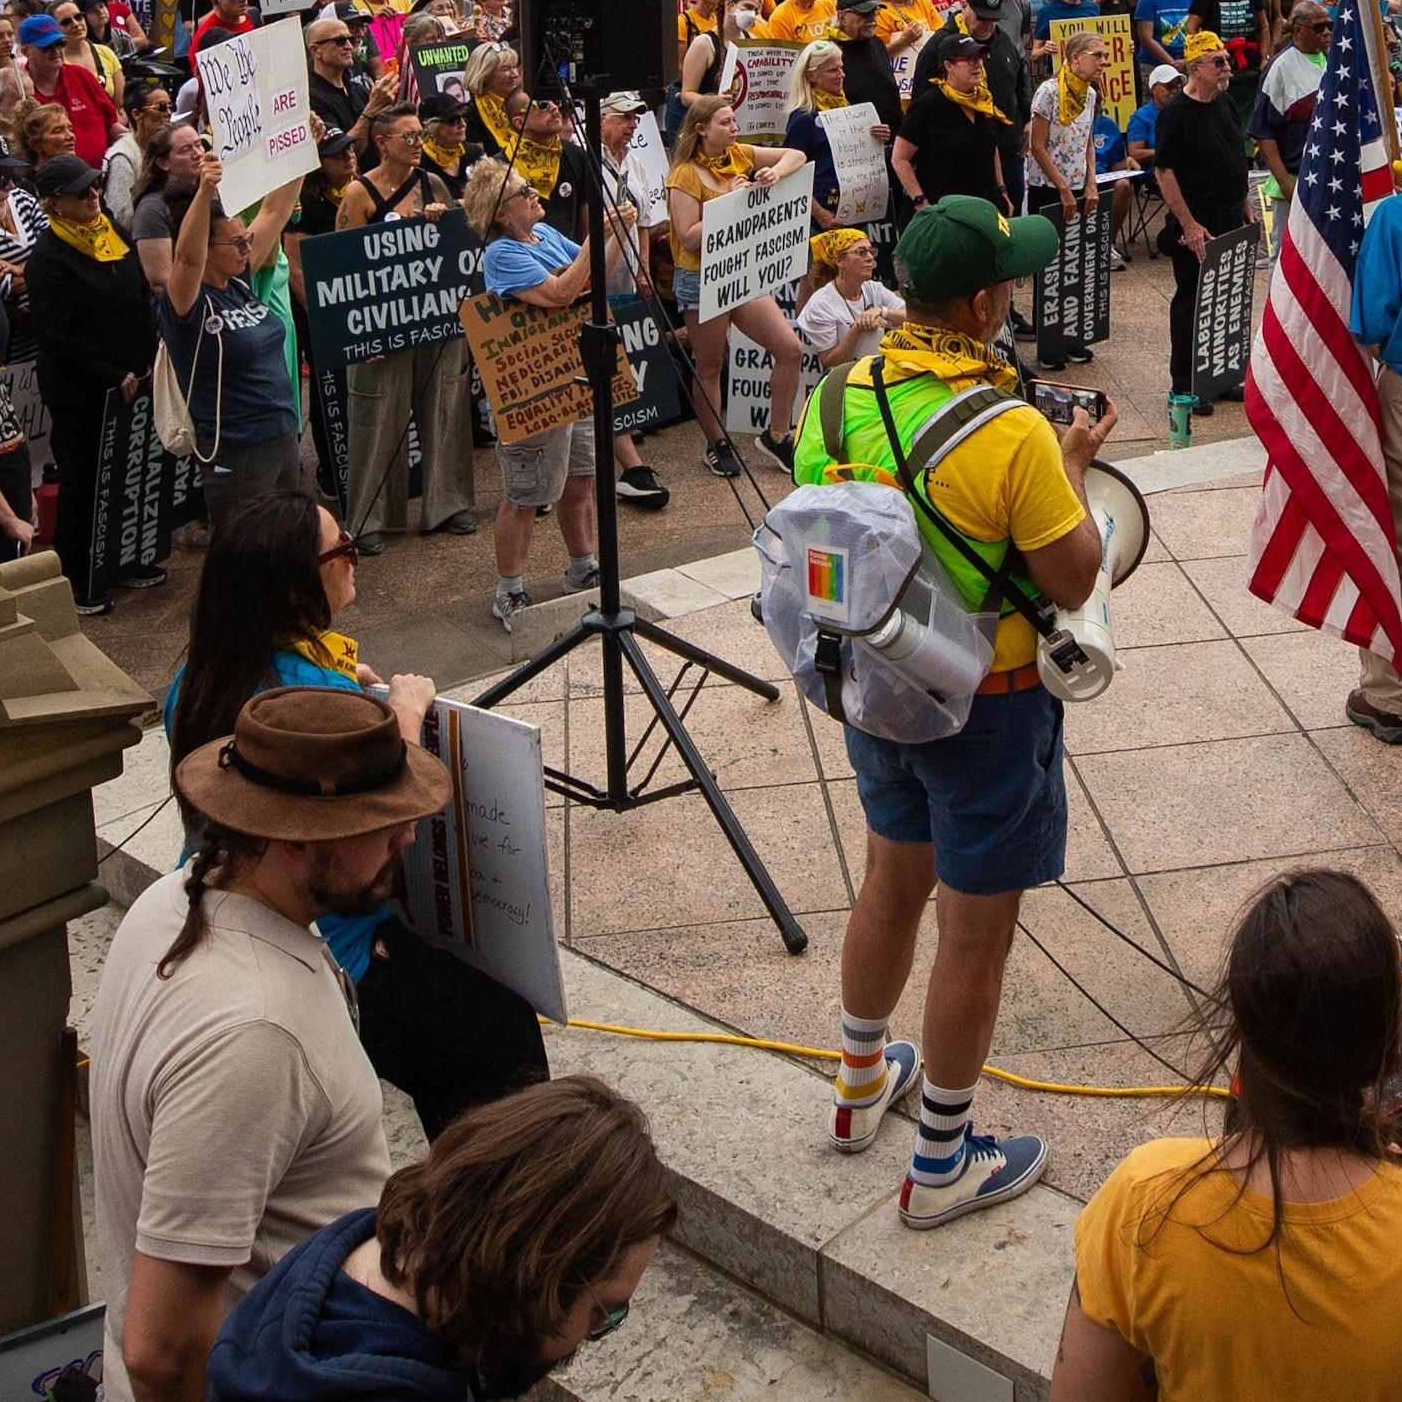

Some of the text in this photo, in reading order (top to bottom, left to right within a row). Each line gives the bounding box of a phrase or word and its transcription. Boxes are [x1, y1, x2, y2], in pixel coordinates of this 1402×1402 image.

[1095, 19, 1129, 35] WILL
[200, 38, 258, 100] We The
[417, 44, 470, 67] UNWANTED
[747, 58, 795, 69] CAPABILITY
[784, 50, 798, 58] THE
[218, 93, 265, 161] People
[273, 90, 297, 115] ARE
[824, 114, 841, 126] The
[268, 125, 307, 156] PISSED
[836, 140, 867, 155] People
[748, 186, 772, 209] OUR
[363, 222, 442, 261] USING
[706, 195, 808, 254] GRANDPARENTS
[316, 255, 445, 308] MILITARY
[704, 225, 807, 286] FOUGHT FASCISM.
[717, 255, 793, 309] WILL YOU?
[1063, 211, 1082, 338] AND FAKING
[1098, 210, 1112, 318] THIS IS FASCISM
[347, 285, 472, 336] CIVILIANS
[1083, 240, 1097, 341] GOVERNMENT
[1212, 249, 1234, 378] MINORITIES
[1227, 239, 1248, 371] AS ENEMIES
[1242, 244, 1257, 359] THIS IS FASCISM
[343, 321, 466, 361] THIS IS FASCIS
[480, 306, 590, 361] IMMIGRANTS
[1197, 268, 1216, 373] LABELING
[327, 400, 341, 419] IS
[506, 387, 574, 430] EQUALITY
[95, 416, 117, 569] THIS IS FASCISM
[119, 395, 149, 567] CORRUPTION
